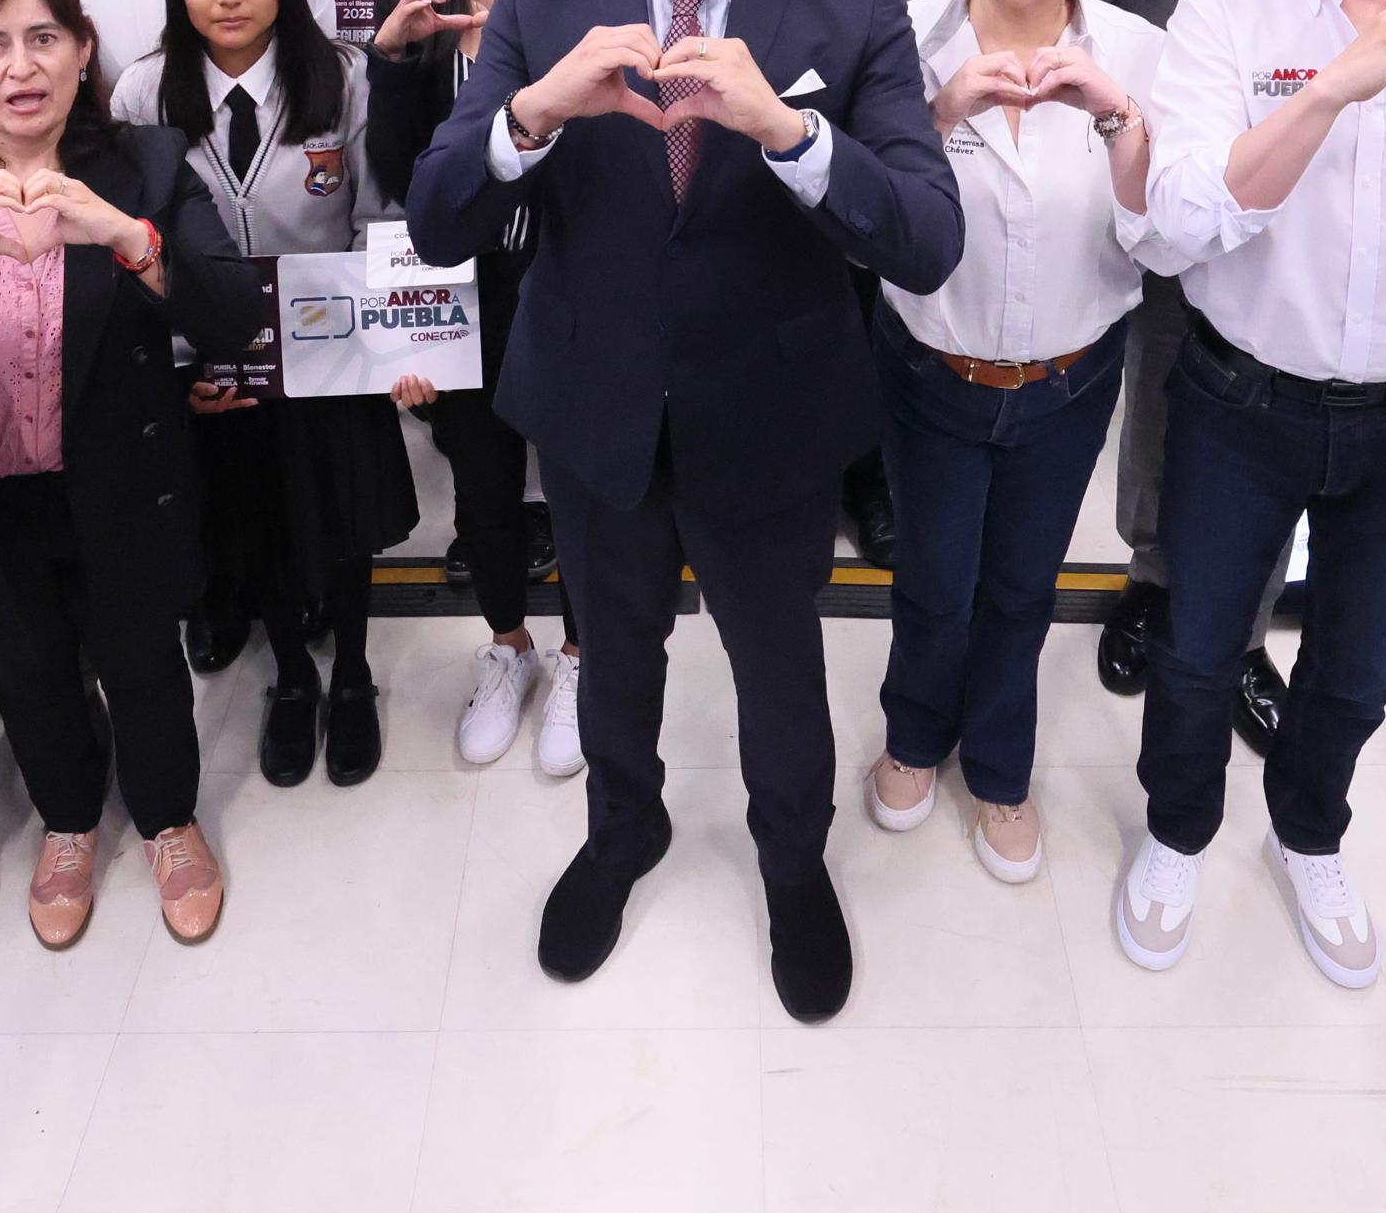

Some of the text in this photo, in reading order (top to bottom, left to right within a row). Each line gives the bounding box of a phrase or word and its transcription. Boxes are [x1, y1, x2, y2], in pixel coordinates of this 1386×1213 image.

[343, 8, 373, 19] 2025
[1252, 72, 1272, 81] POR
[949, 138, 984, 147] Artemisa
[945, 145, 974, 155] Chávez
[361, 289, 460, 307] POR AMOR A
[361, 305, 469, 330] PUEBLA
[410, 332, 461, 342] CONECTA
